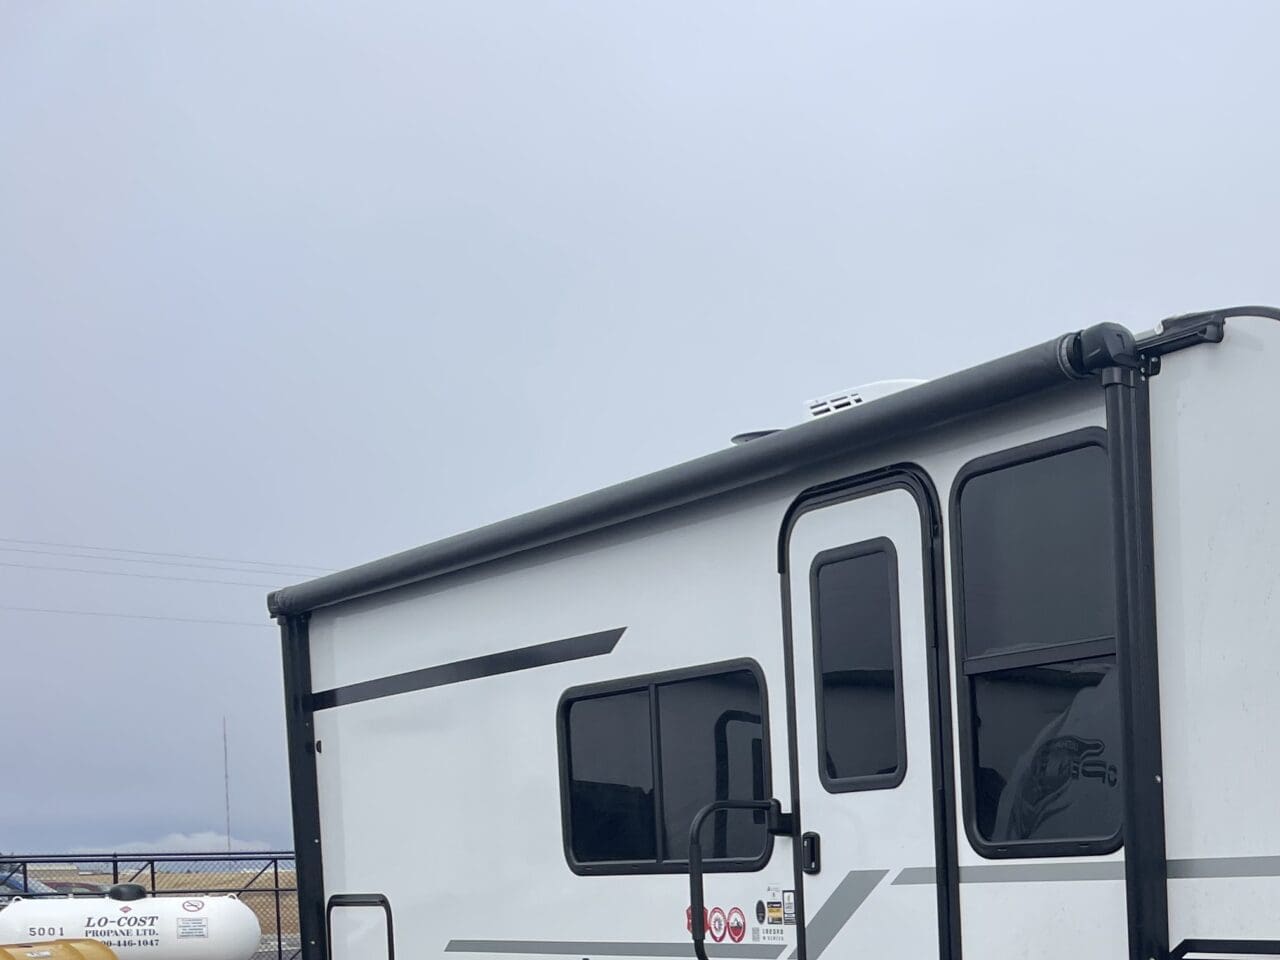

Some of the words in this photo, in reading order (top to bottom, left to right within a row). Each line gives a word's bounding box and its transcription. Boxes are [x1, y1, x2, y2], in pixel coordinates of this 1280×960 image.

[85, 916, 159, 928] LO-COST
[29, 927, 65, 937] 5001
[85, 929, 134, 938] PROPANE
[135, 929, 159, 937] LTD.
